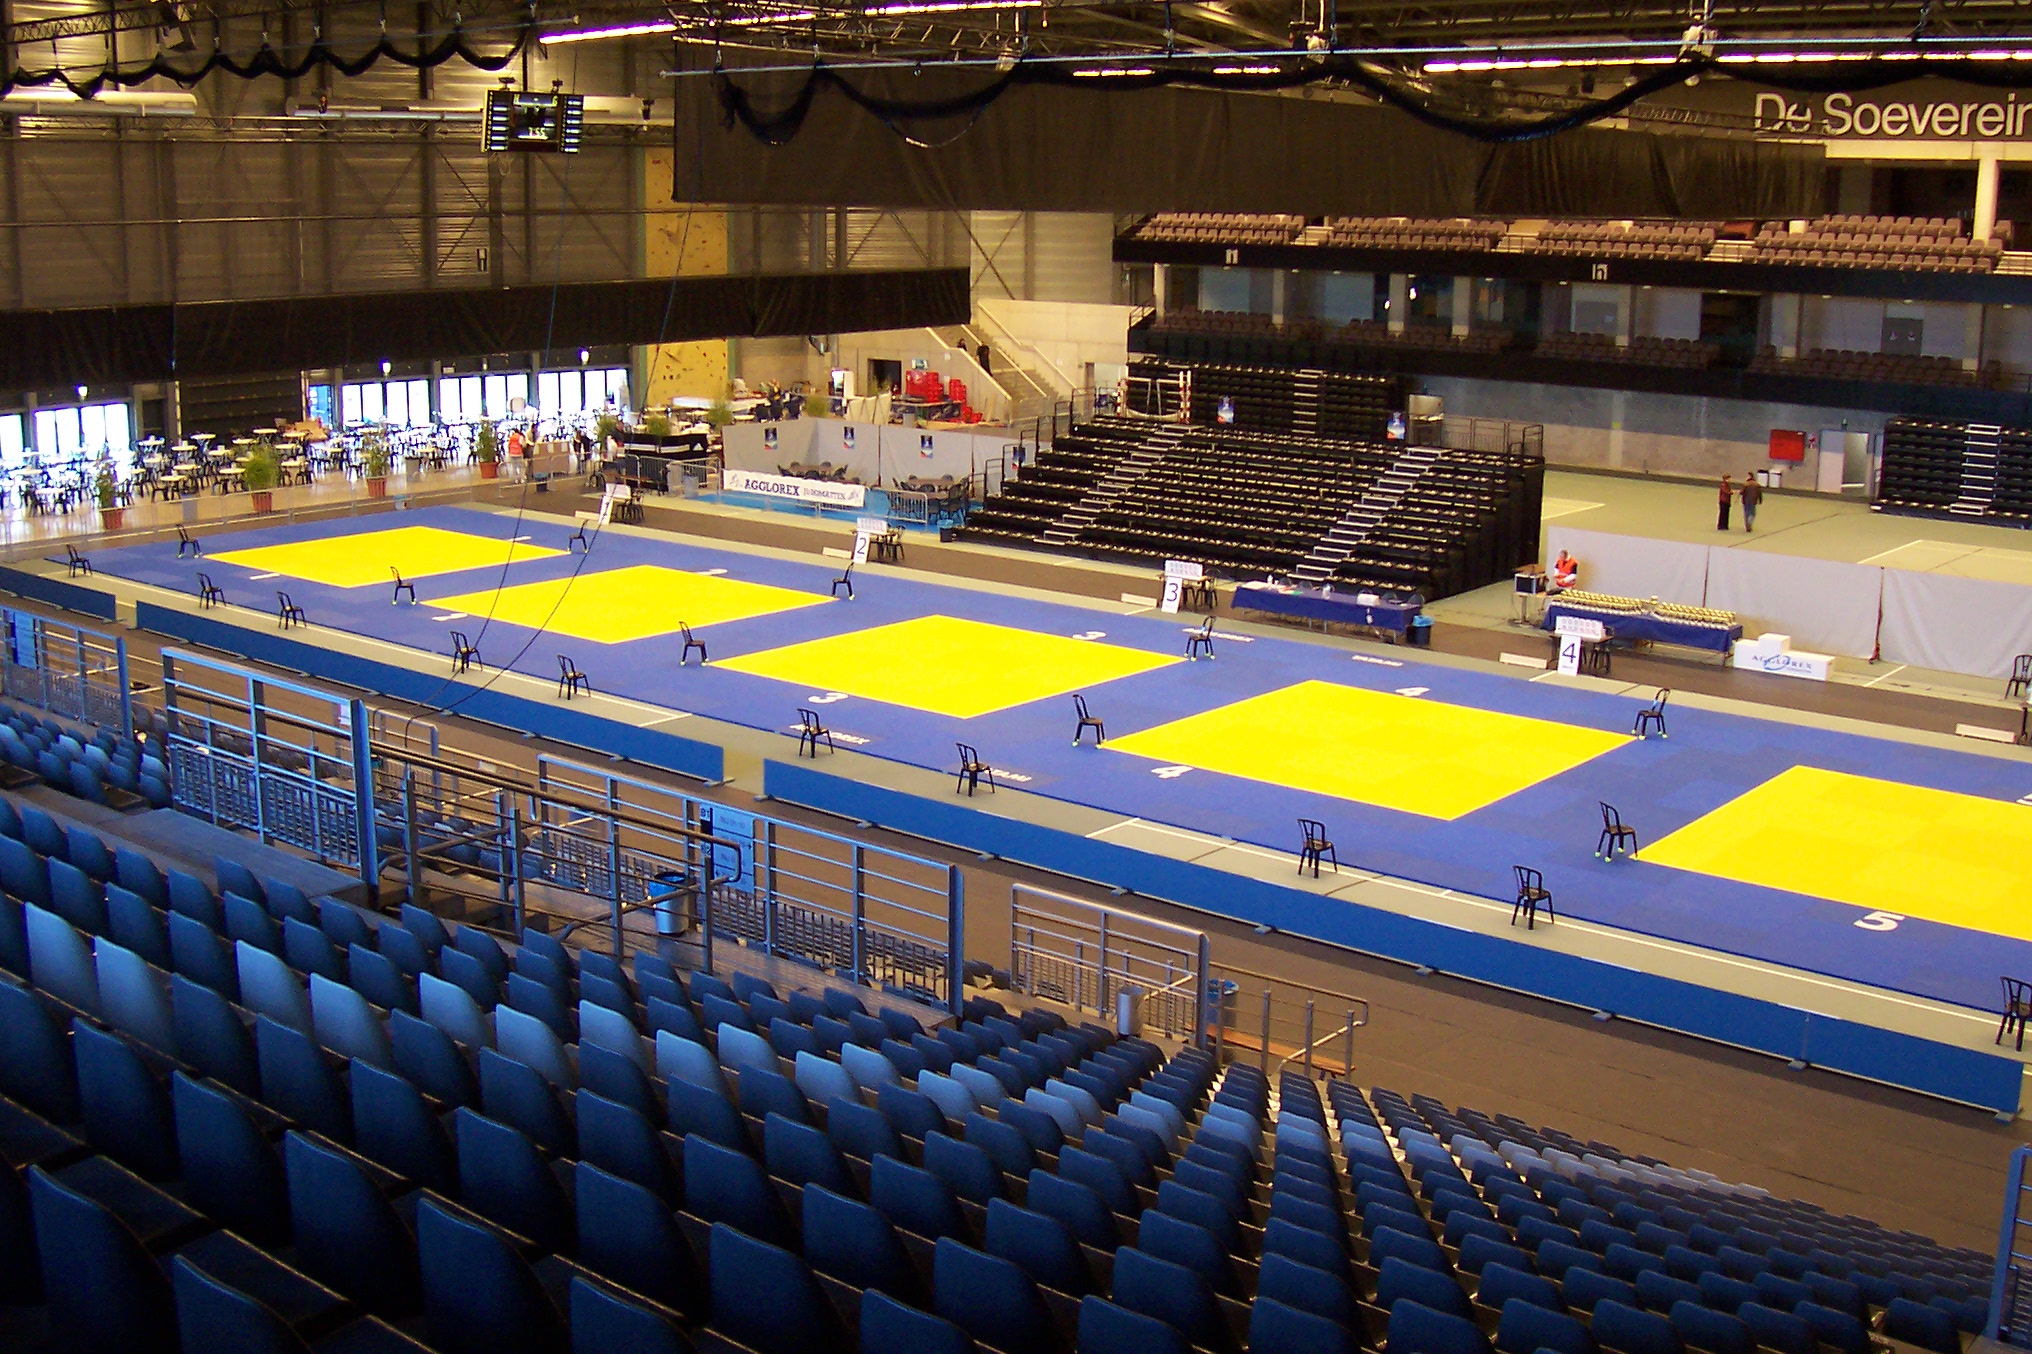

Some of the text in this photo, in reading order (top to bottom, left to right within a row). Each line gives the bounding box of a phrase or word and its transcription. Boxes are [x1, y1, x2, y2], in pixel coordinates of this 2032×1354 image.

[744, 478, 801, 497] AGGLOREX
[857, 537, 867, 555] 2
[1166, 582, 1179, 602] 3
[1562, 643, 1576, 664] 4
[1852, 910, 1906, 931] 5
